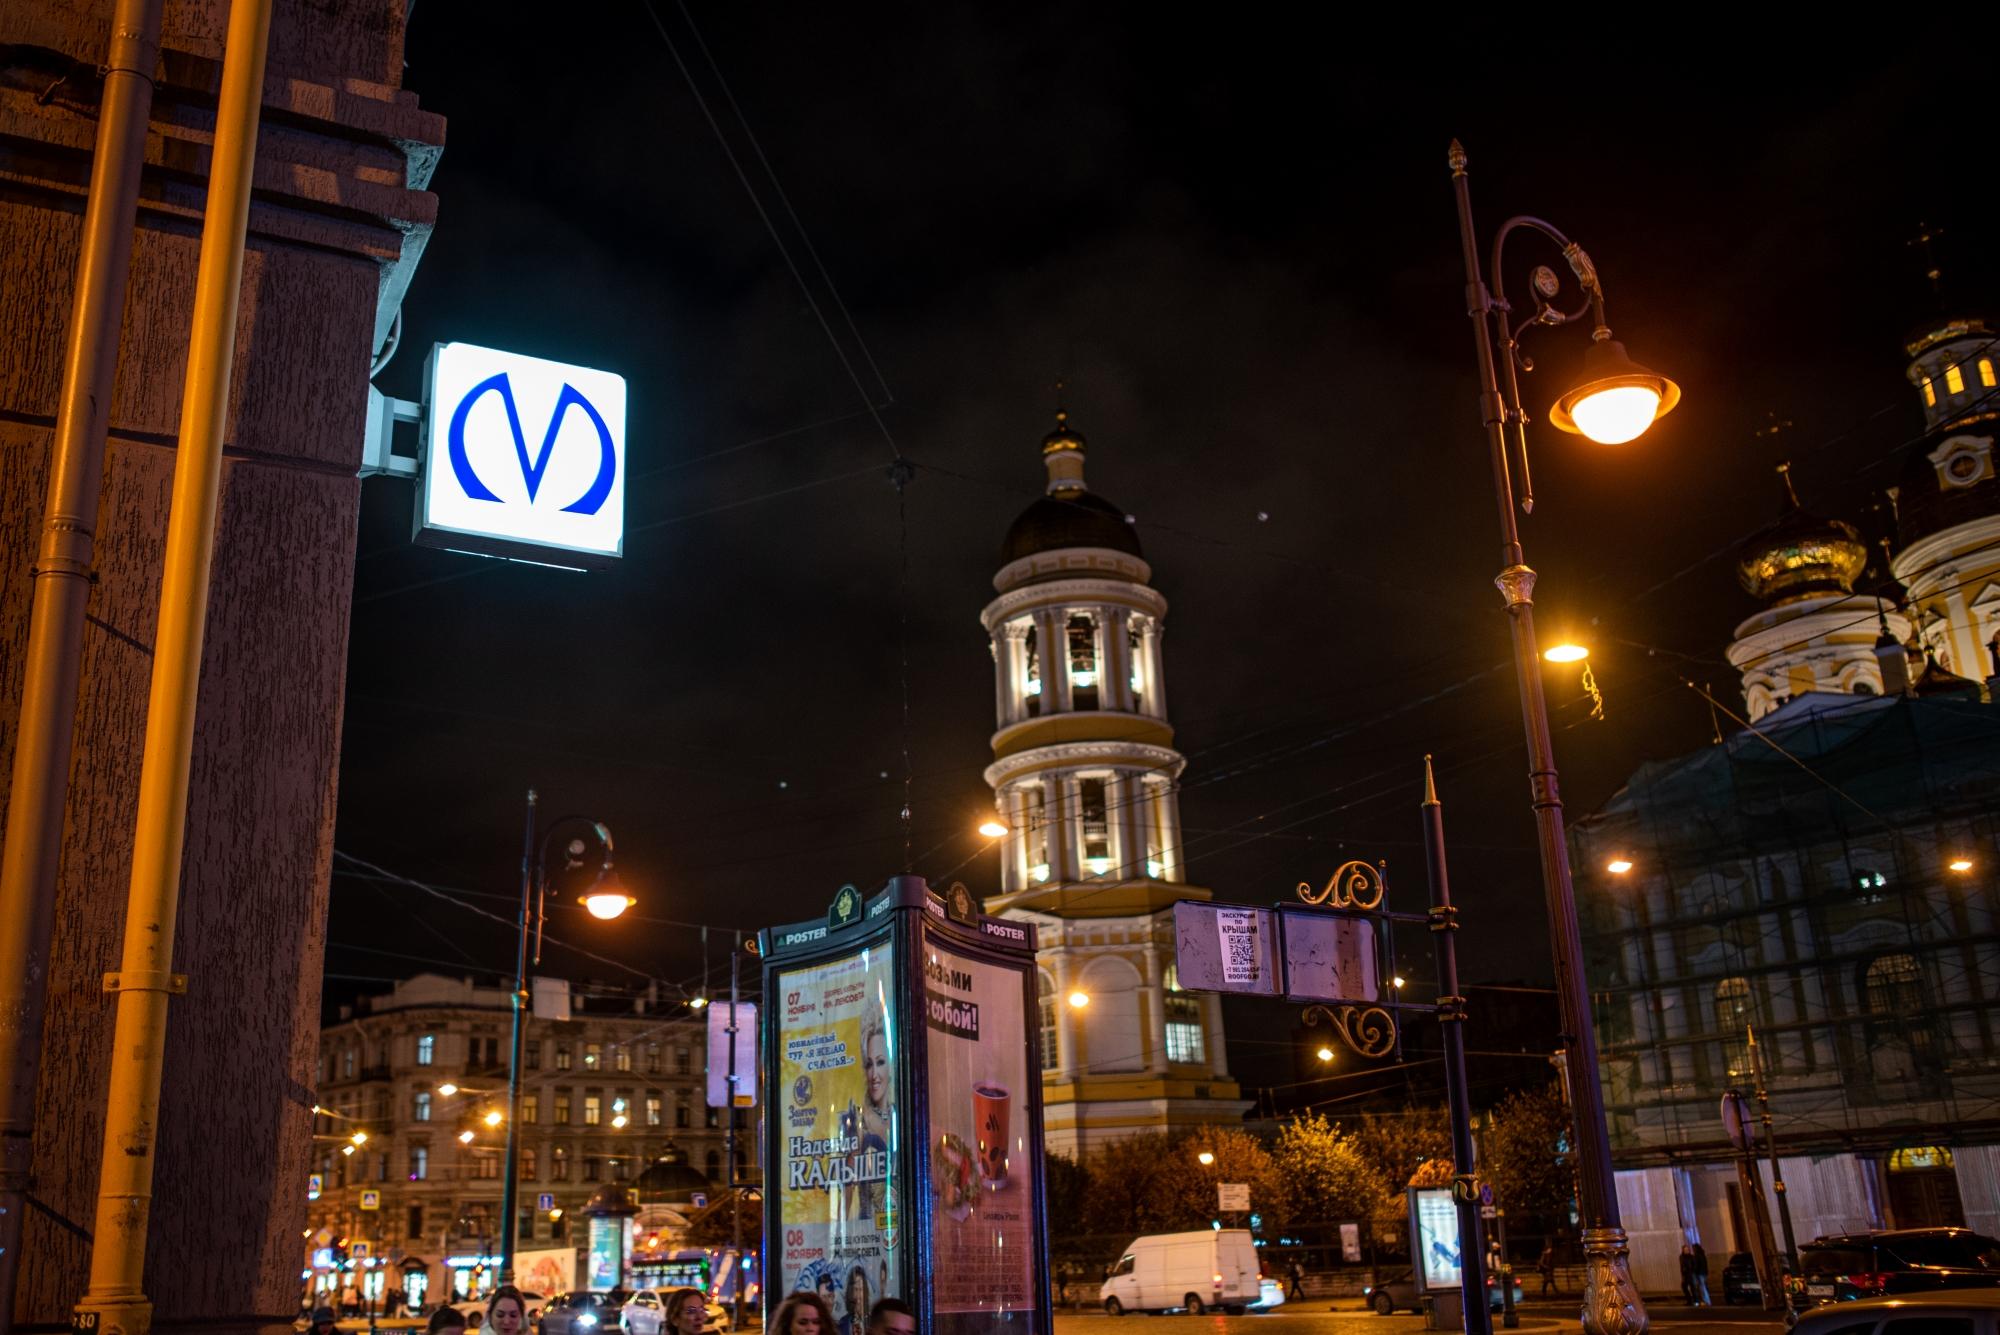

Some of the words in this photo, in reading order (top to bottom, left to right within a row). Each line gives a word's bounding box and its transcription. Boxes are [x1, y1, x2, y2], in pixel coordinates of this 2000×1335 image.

[871, 896, 889, 918] POSTER
[926, 896, 944, 919] POSTER
[786, 927, 827, 944] POSTER
[986, 923, 1025, 941] POSTER
[1222, 926, 1257, 934] КРЫШАМ
[788, 992, 800, 1005] 07
[788, 1003, 815, 1015] НОЯБРЯ
[931, 1001, 977, 1031] собой!
[789, 1136, 859, 1157] Надеда
[787, 1230, 804, 1246] 08
[787, 1248, 823, 1260] НОЯБРЯ
